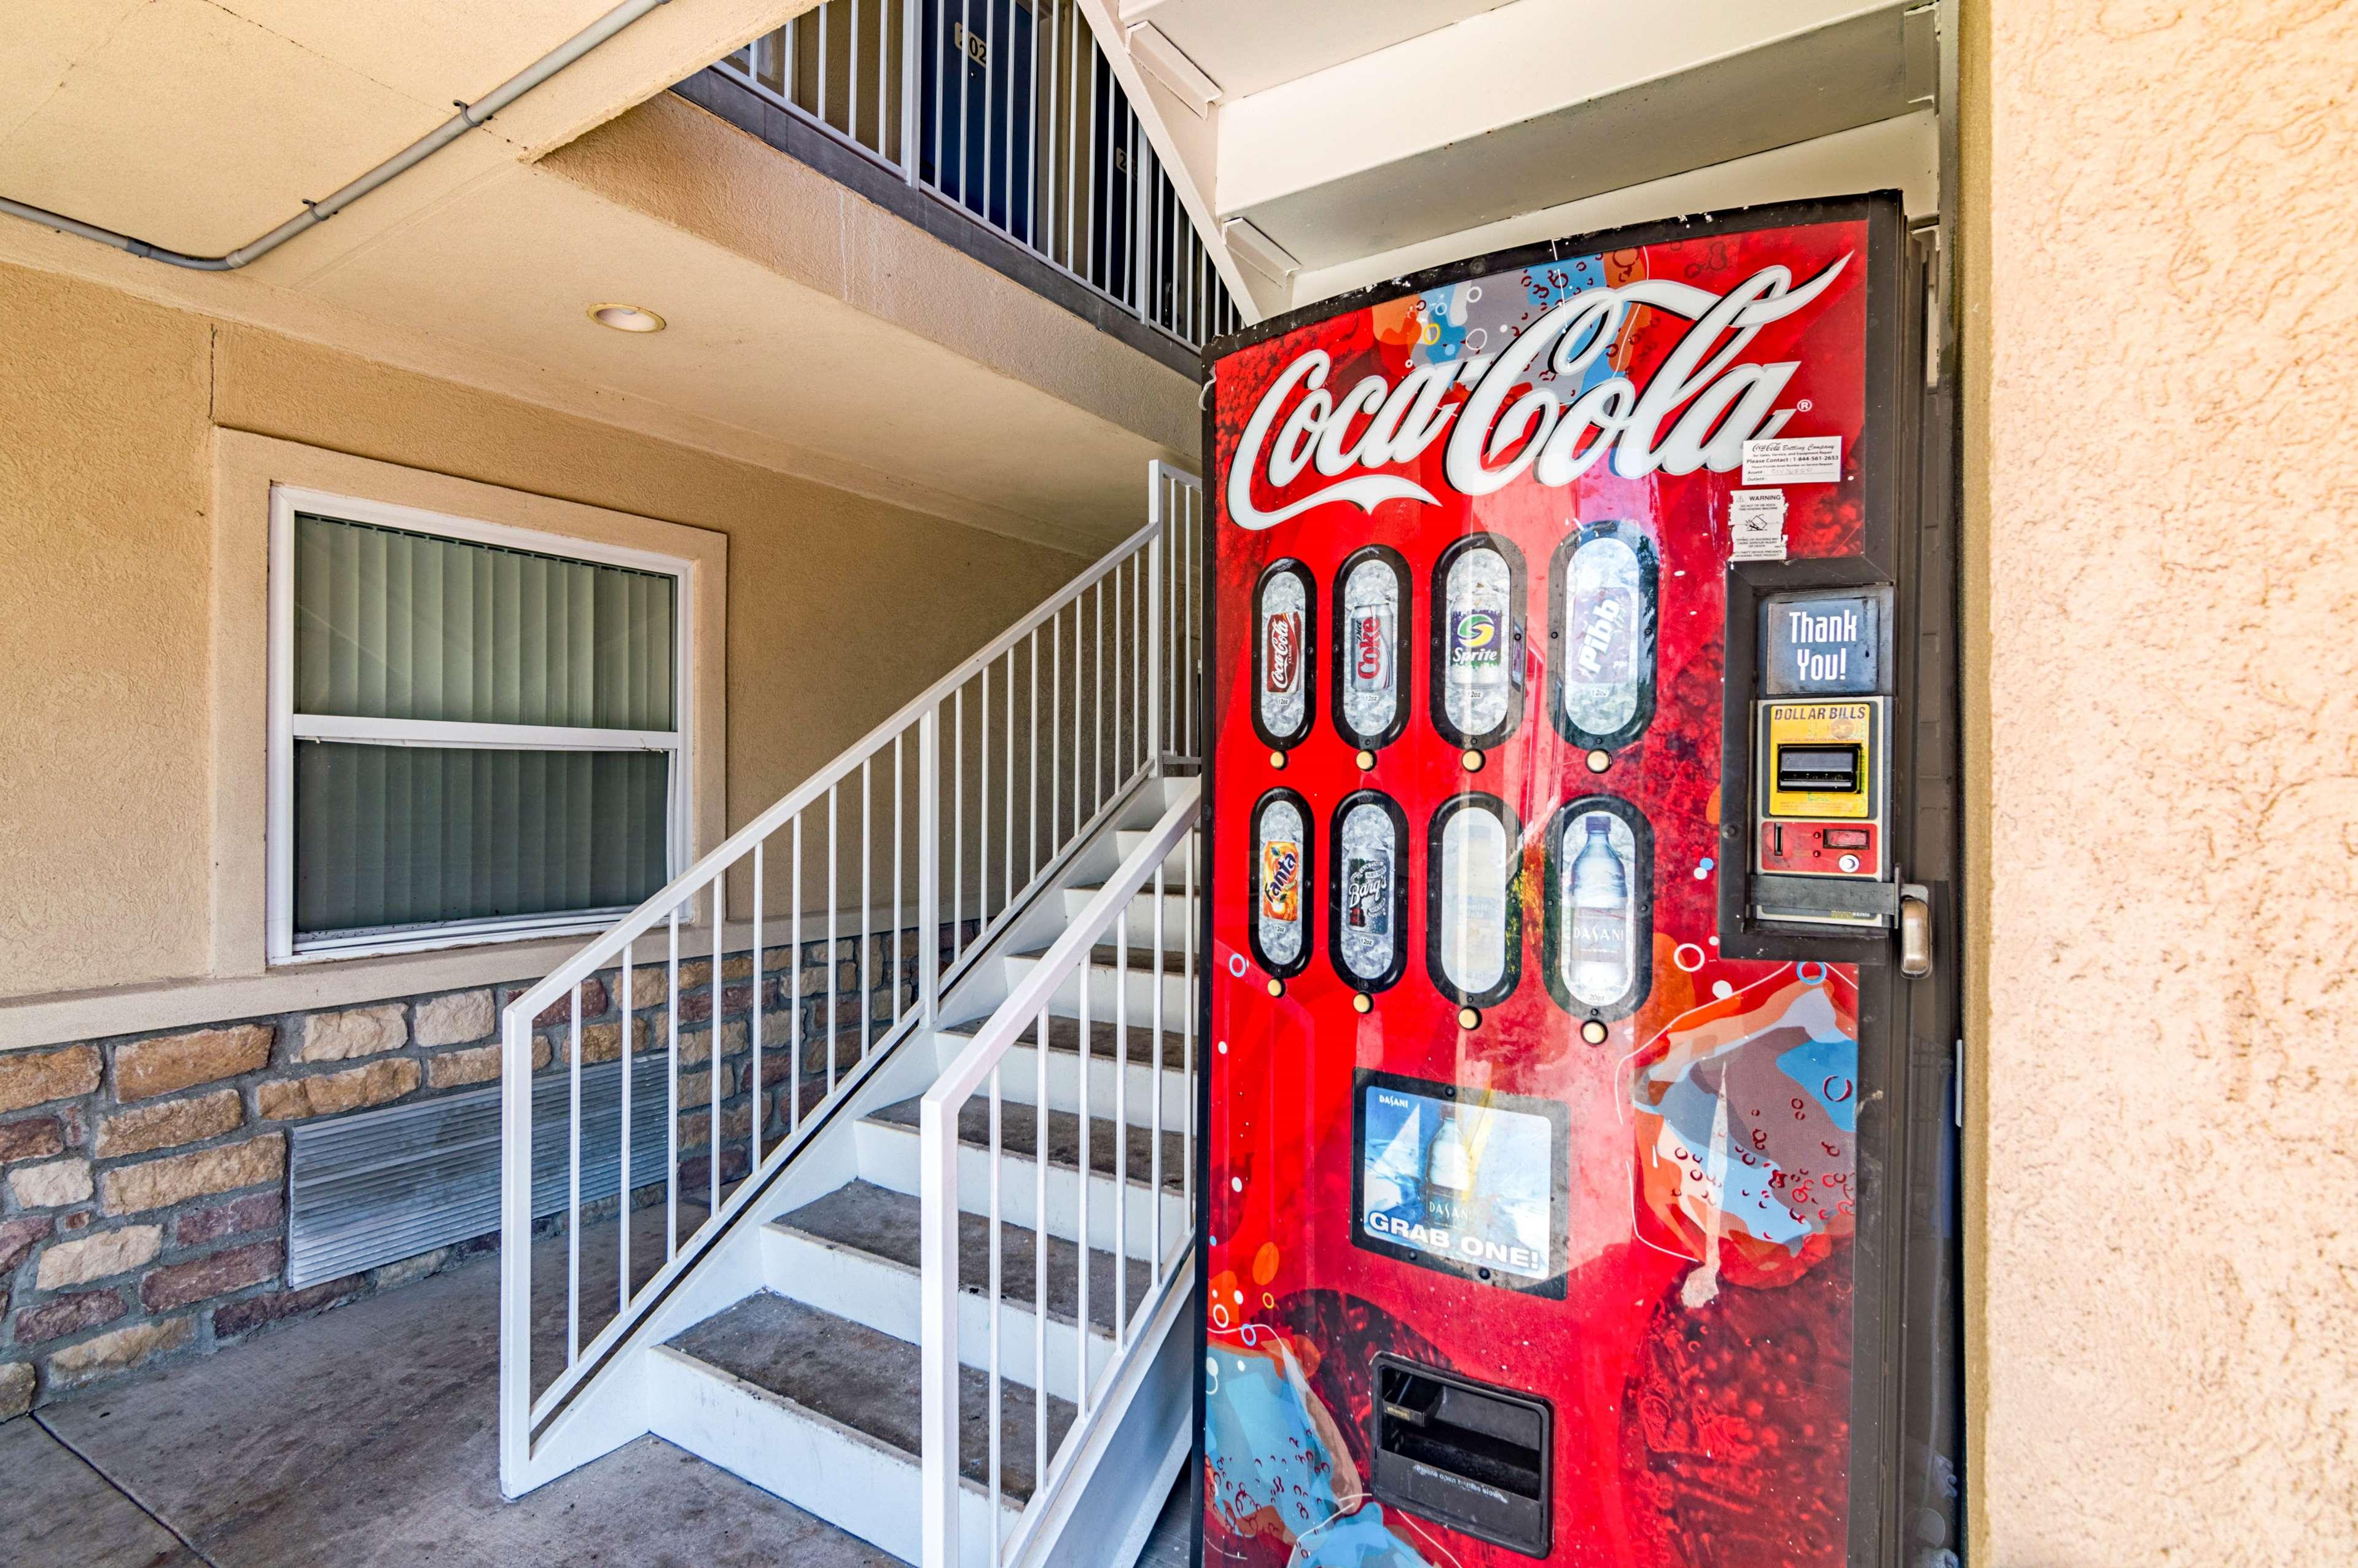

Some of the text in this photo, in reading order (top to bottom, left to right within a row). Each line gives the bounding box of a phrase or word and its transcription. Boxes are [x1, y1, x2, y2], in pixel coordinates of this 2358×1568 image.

[959, 29, 986, 64] 02
[1227, 251, 1854, 530] Coca-Cola
[1579, 599, 1620, 674] Pibb
[1789, 609, 1857, 644] Thank
[1271, 618, 1289, 688] Coca-Cola
[1357, 617, 1381, 679] Coke
[1453, 647, 1497, 664] Sprite
[1797, 647, 1846, 681] You!
[1774, 706, 1866, 720] DOLLAR BILLS
[1265, 853, 1296, 903] Fanta
[1349, 875, 1387, 908] Barq's
[1574, 925, 1624, 941] DASANI
[1379, 1094, 1408, 1109] DASANI
[1429, 1201, 1469, 1221] DASAN
[1368, 1212, 1539, 1270] GRAB ONE!
